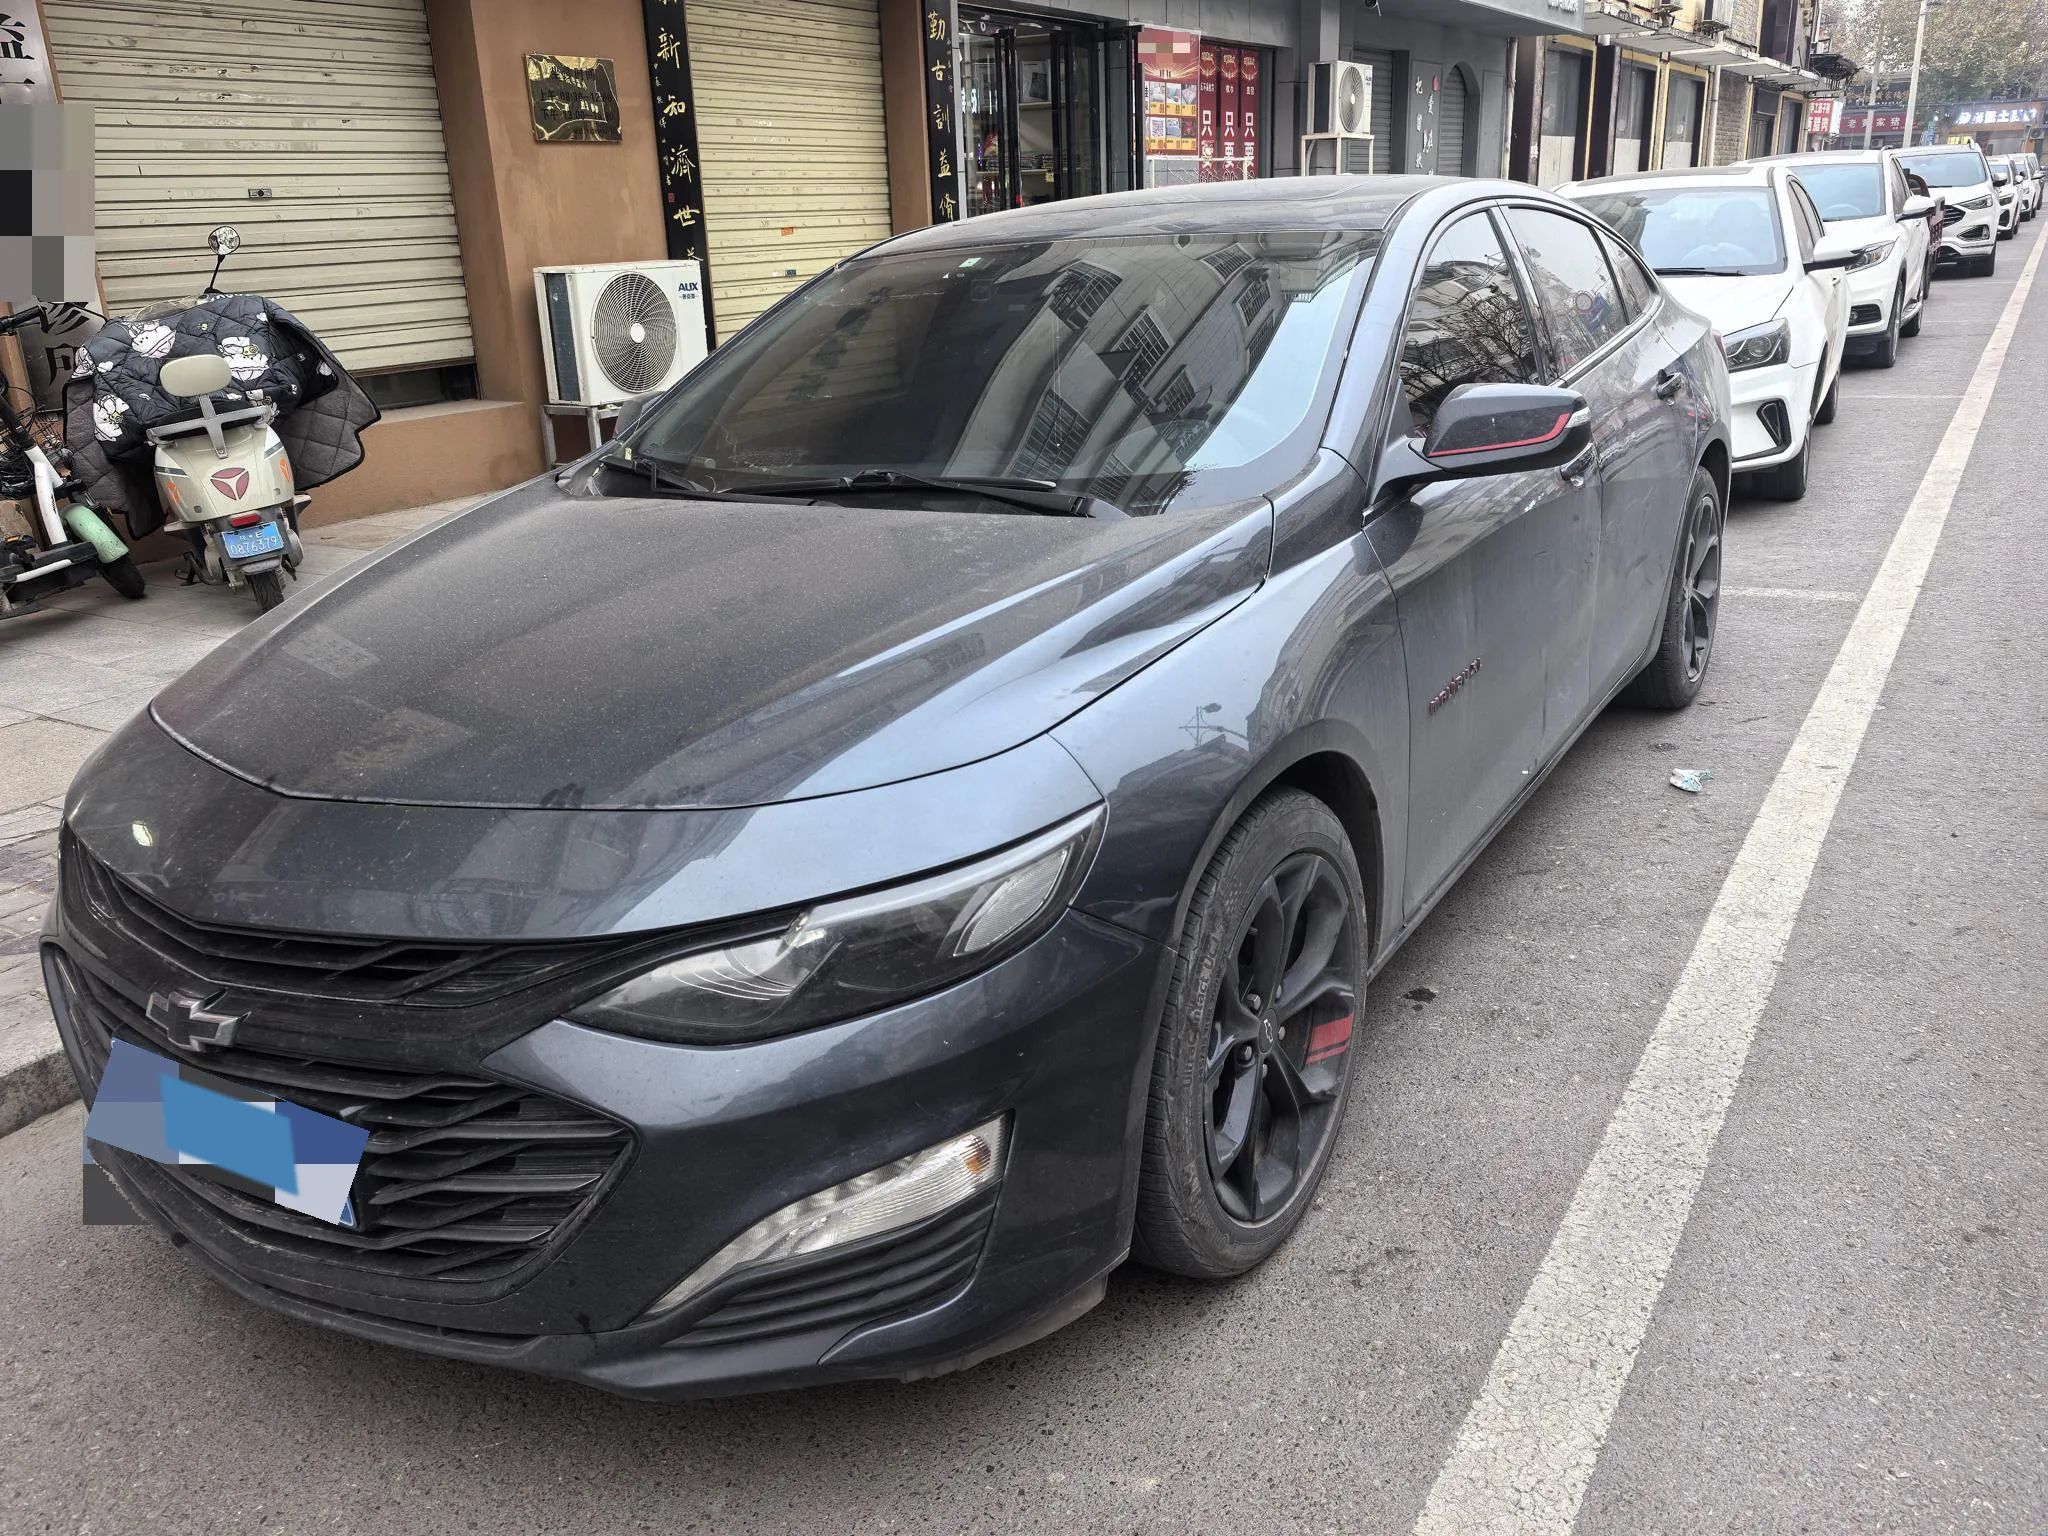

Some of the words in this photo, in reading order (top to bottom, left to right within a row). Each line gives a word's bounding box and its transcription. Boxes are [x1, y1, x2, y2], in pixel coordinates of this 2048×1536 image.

[656, 0, 704, 261] 新知濟世
[678, 283, 698, 291] AUX
[230, 536, 277, 555] 0876379
